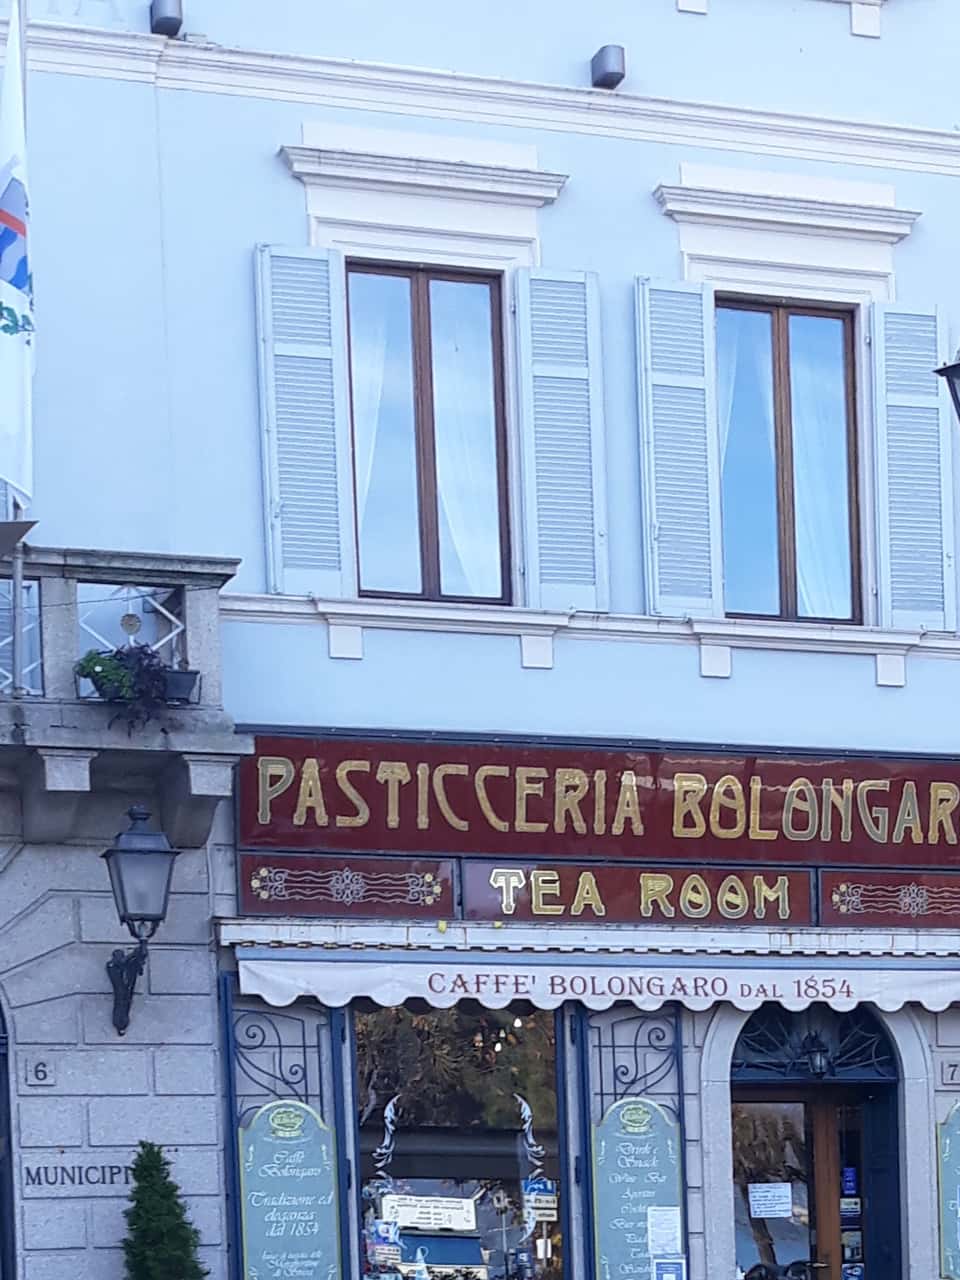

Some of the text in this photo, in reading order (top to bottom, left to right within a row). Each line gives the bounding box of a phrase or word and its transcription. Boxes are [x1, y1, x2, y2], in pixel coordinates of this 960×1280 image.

[257, 756, 644, 836] PASTICCERIA
[489, 869, 790, 919] TEA ROOM
[428, 972, 854, 998] CAFFE' BOLONGARO DAL 1854
[34, 1062, 48, 1081] 6
[948, 1063, 959, 1081] 7
[24, 1165, 131, 1186] MUNICIPI
